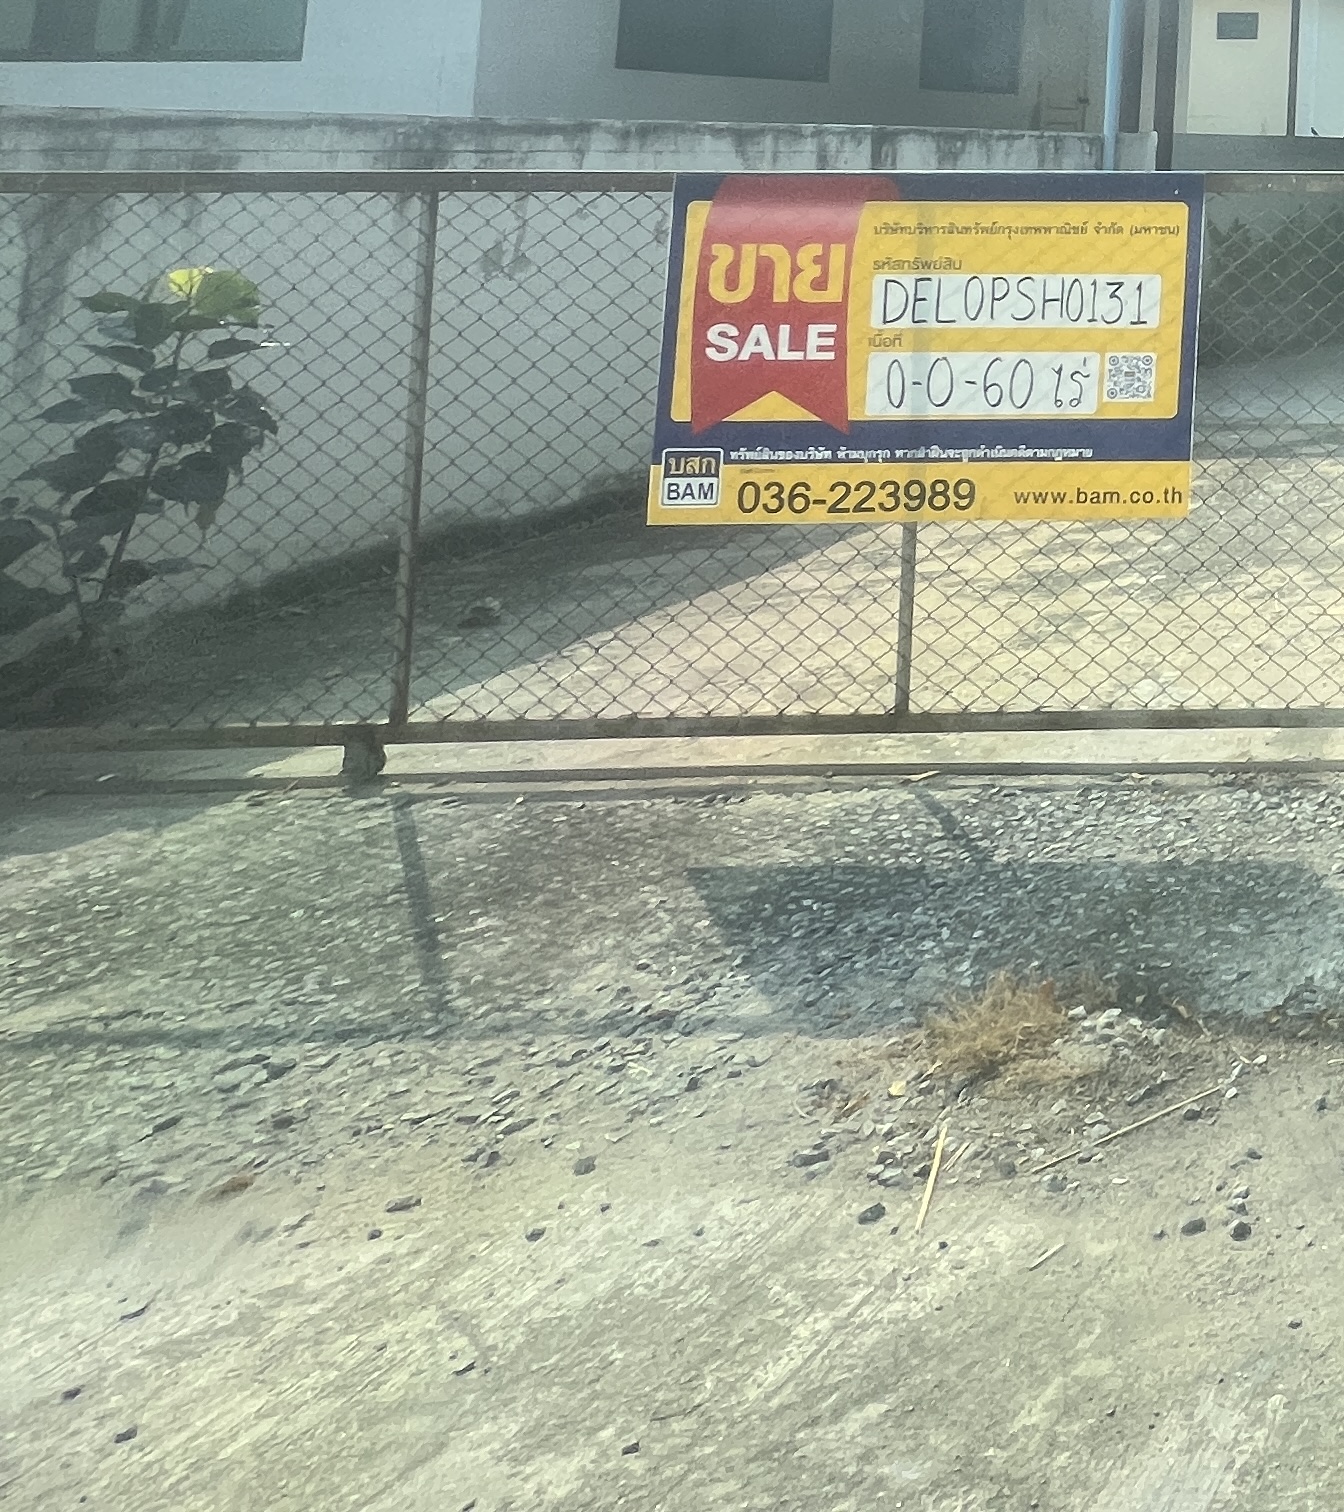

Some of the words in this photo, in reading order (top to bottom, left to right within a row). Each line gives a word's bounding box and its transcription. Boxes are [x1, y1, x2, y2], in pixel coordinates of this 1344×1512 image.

[1093, 223, 1124, 235] จำกัด
[1129, 224, 1180, 236] (มหาชน)
[708, 243, 846, 304] ขาย
[705, 323, 838, 362] SALE
[886, 356, 1034, 409] 0-0-60
[1051, 356, 1090, 409] ไร่
[668, 456, 716, 475] บสก
[667, 482, 714, 500] BAM
[737, 478, 976, 514] 036-223989
[1013, 486, 1183, 504] www.bam.co.th
